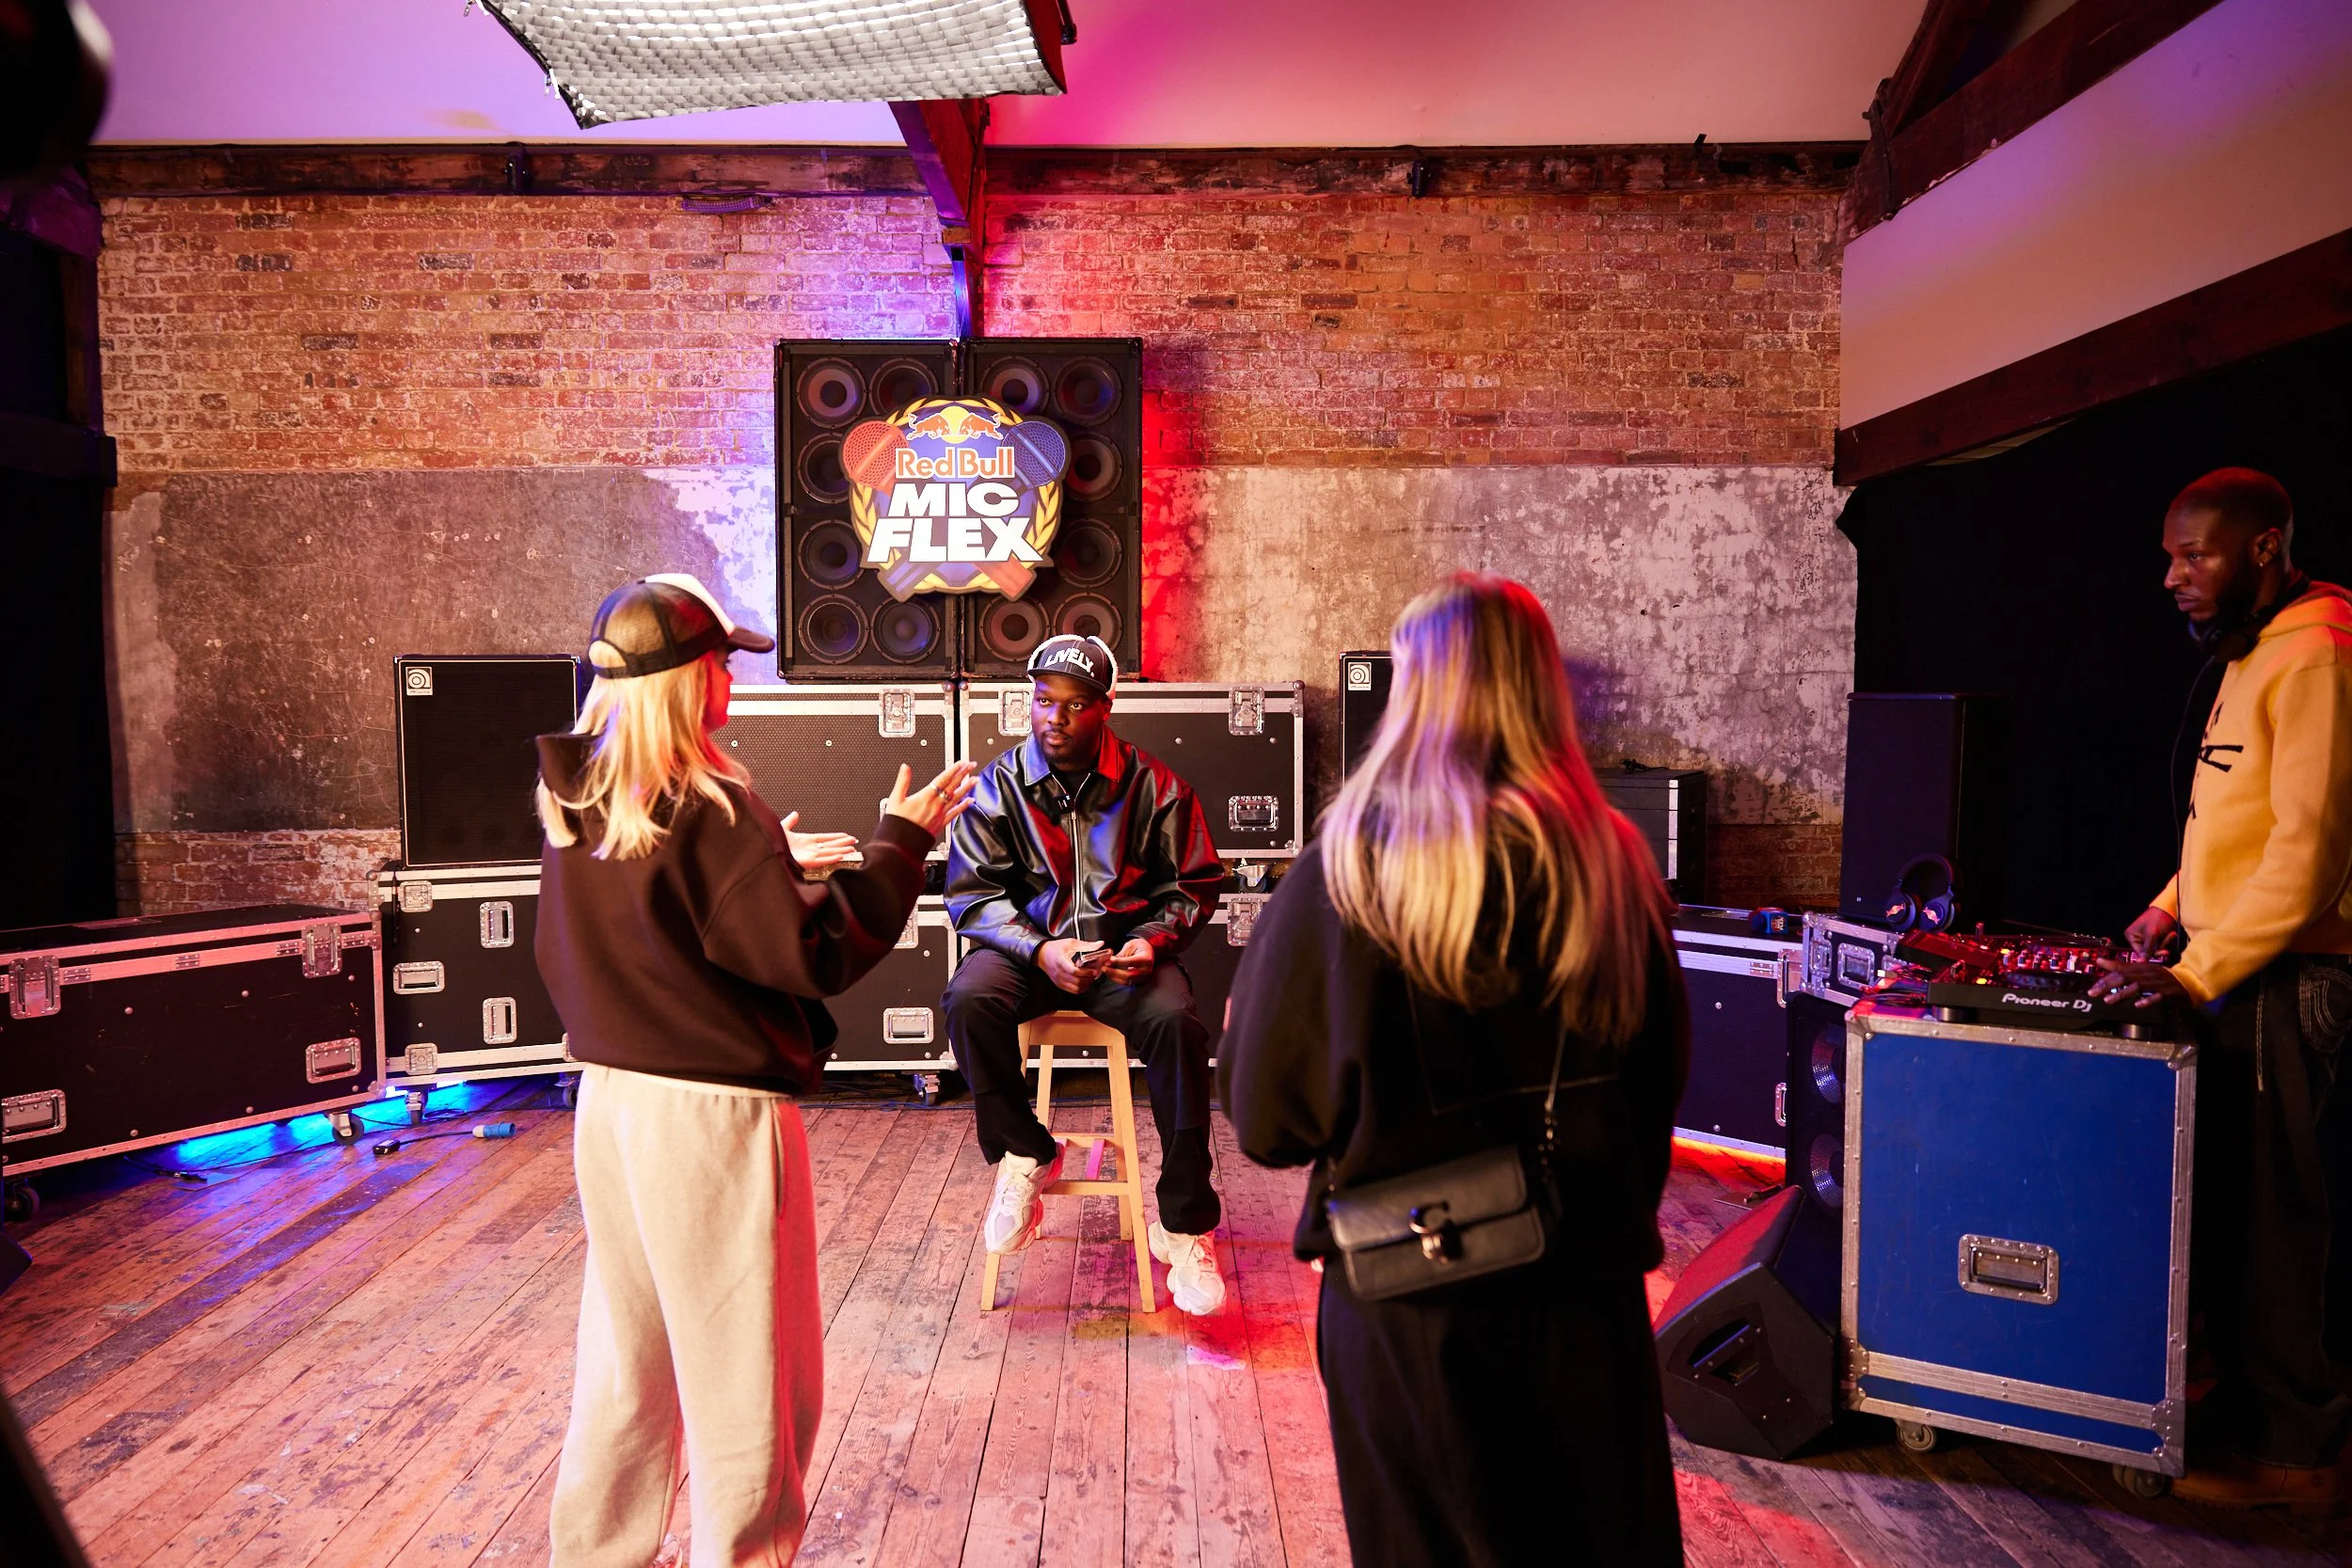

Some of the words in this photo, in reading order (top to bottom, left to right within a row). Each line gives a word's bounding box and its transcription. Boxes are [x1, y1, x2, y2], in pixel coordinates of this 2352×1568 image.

[897, 448, 955, 478] Red
[959, 448, 1014, 478] Bull
[887, 483, 1019, 517] MIC
[866, 517, 1043, 562] FLEX
[2001, 992, 2070, 1008] Pioneer
